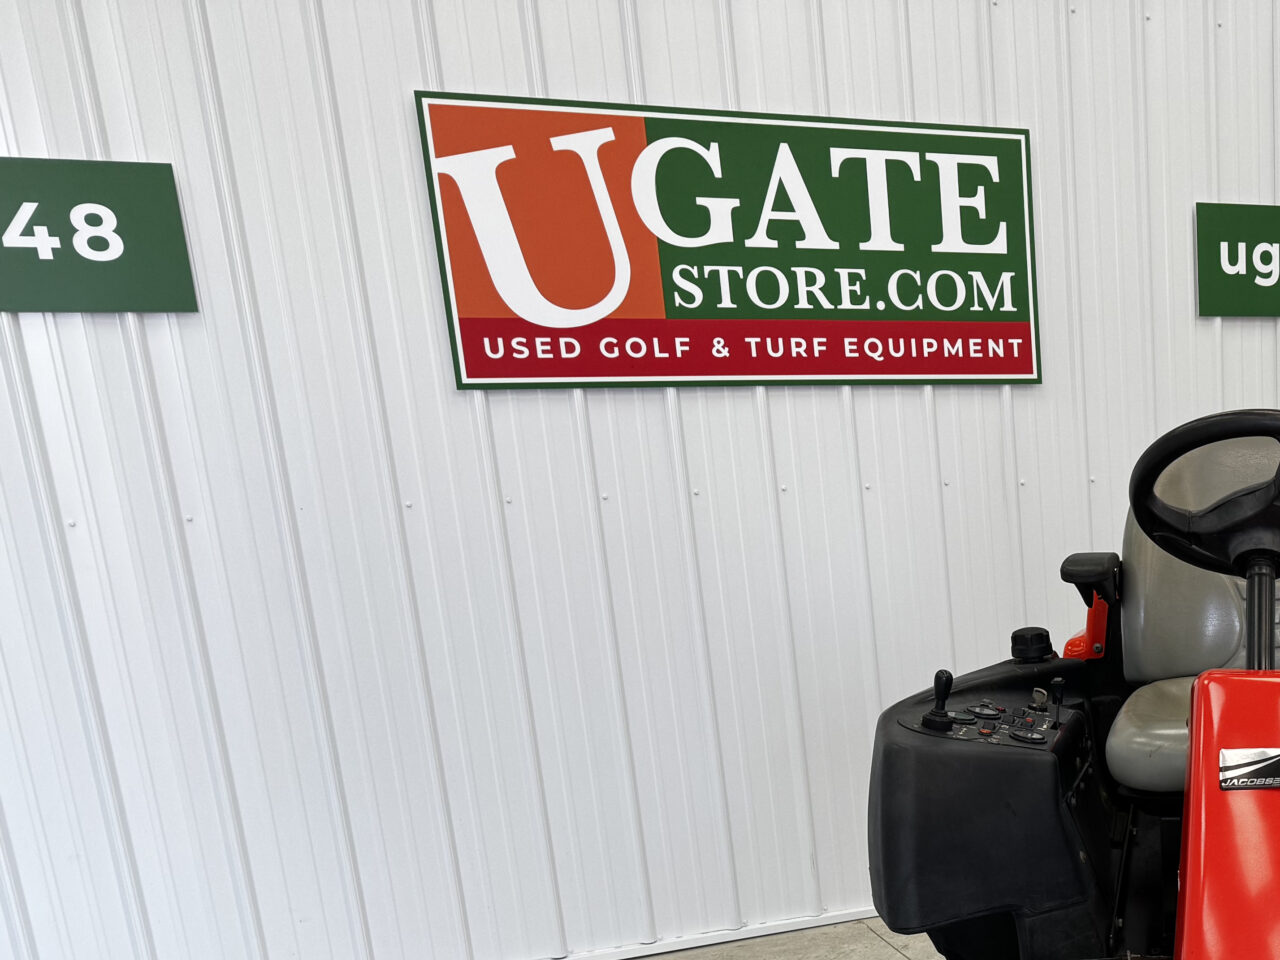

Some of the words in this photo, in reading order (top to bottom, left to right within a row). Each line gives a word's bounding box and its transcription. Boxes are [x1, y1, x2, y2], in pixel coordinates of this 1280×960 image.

[1, 201, 125, 262] 48
[435, 126, 1008, 328] UGATE
[672, 264, 1018, 312] STORE.COM
[483, 337, 581, 359] USED
[599, 337, 690, 358] GOLF
[711, 337, 730, 358] &
[744, 337, 827, 358] TURF
[843, 337, 1023, 362] EQUIPMENT
